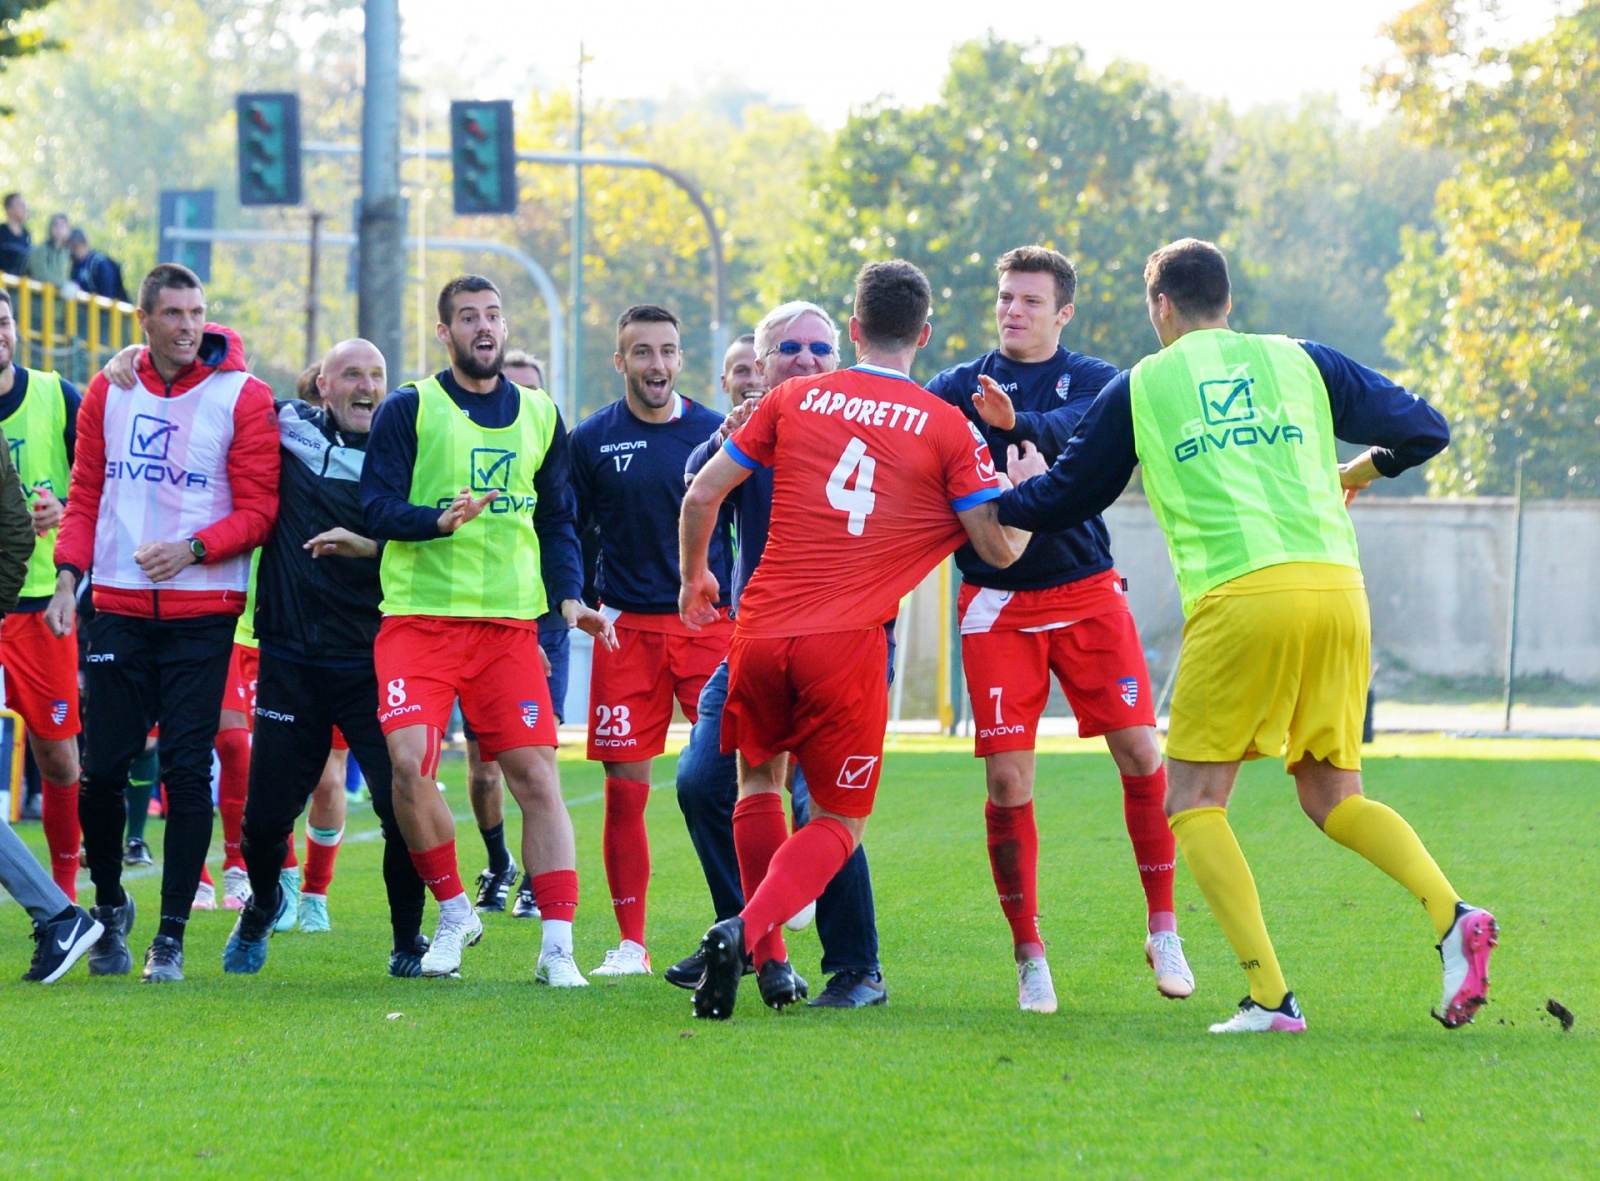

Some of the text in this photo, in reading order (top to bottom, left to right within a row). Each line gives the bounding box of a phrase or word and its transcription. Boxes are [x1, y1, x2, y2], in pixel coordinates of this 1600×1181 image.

[799, 387, 929, 435] SAPORETTI
[288, 430, 321, 451] GIVOVA
[600, 440, 647, 453] GIVOVA
[1174, 425, 1303, 463] GIVOVA
[613, 453, 634, 472] 17
[106, 461, 208, 488] GIVOVA
[825, 436, 876, 536] 4
[437, 496, 537, 514] GOVA
[86, 653, 114, 663] VOVA
[387, 678, 407, 707] 8
[989, 686, 1004, 725] 7
[256, 707, 295, 723] GIVOVA
[595, 704, 632, 737] 23
[980, 724, 1025, 739] GIVOVA
[594, 738, 638, 747] GIVOVA
[1139, 860, 1176, 872] GIVOV
[612, 896, 636, 906] OVA
[1240, 959, 1261, 970] OVA
